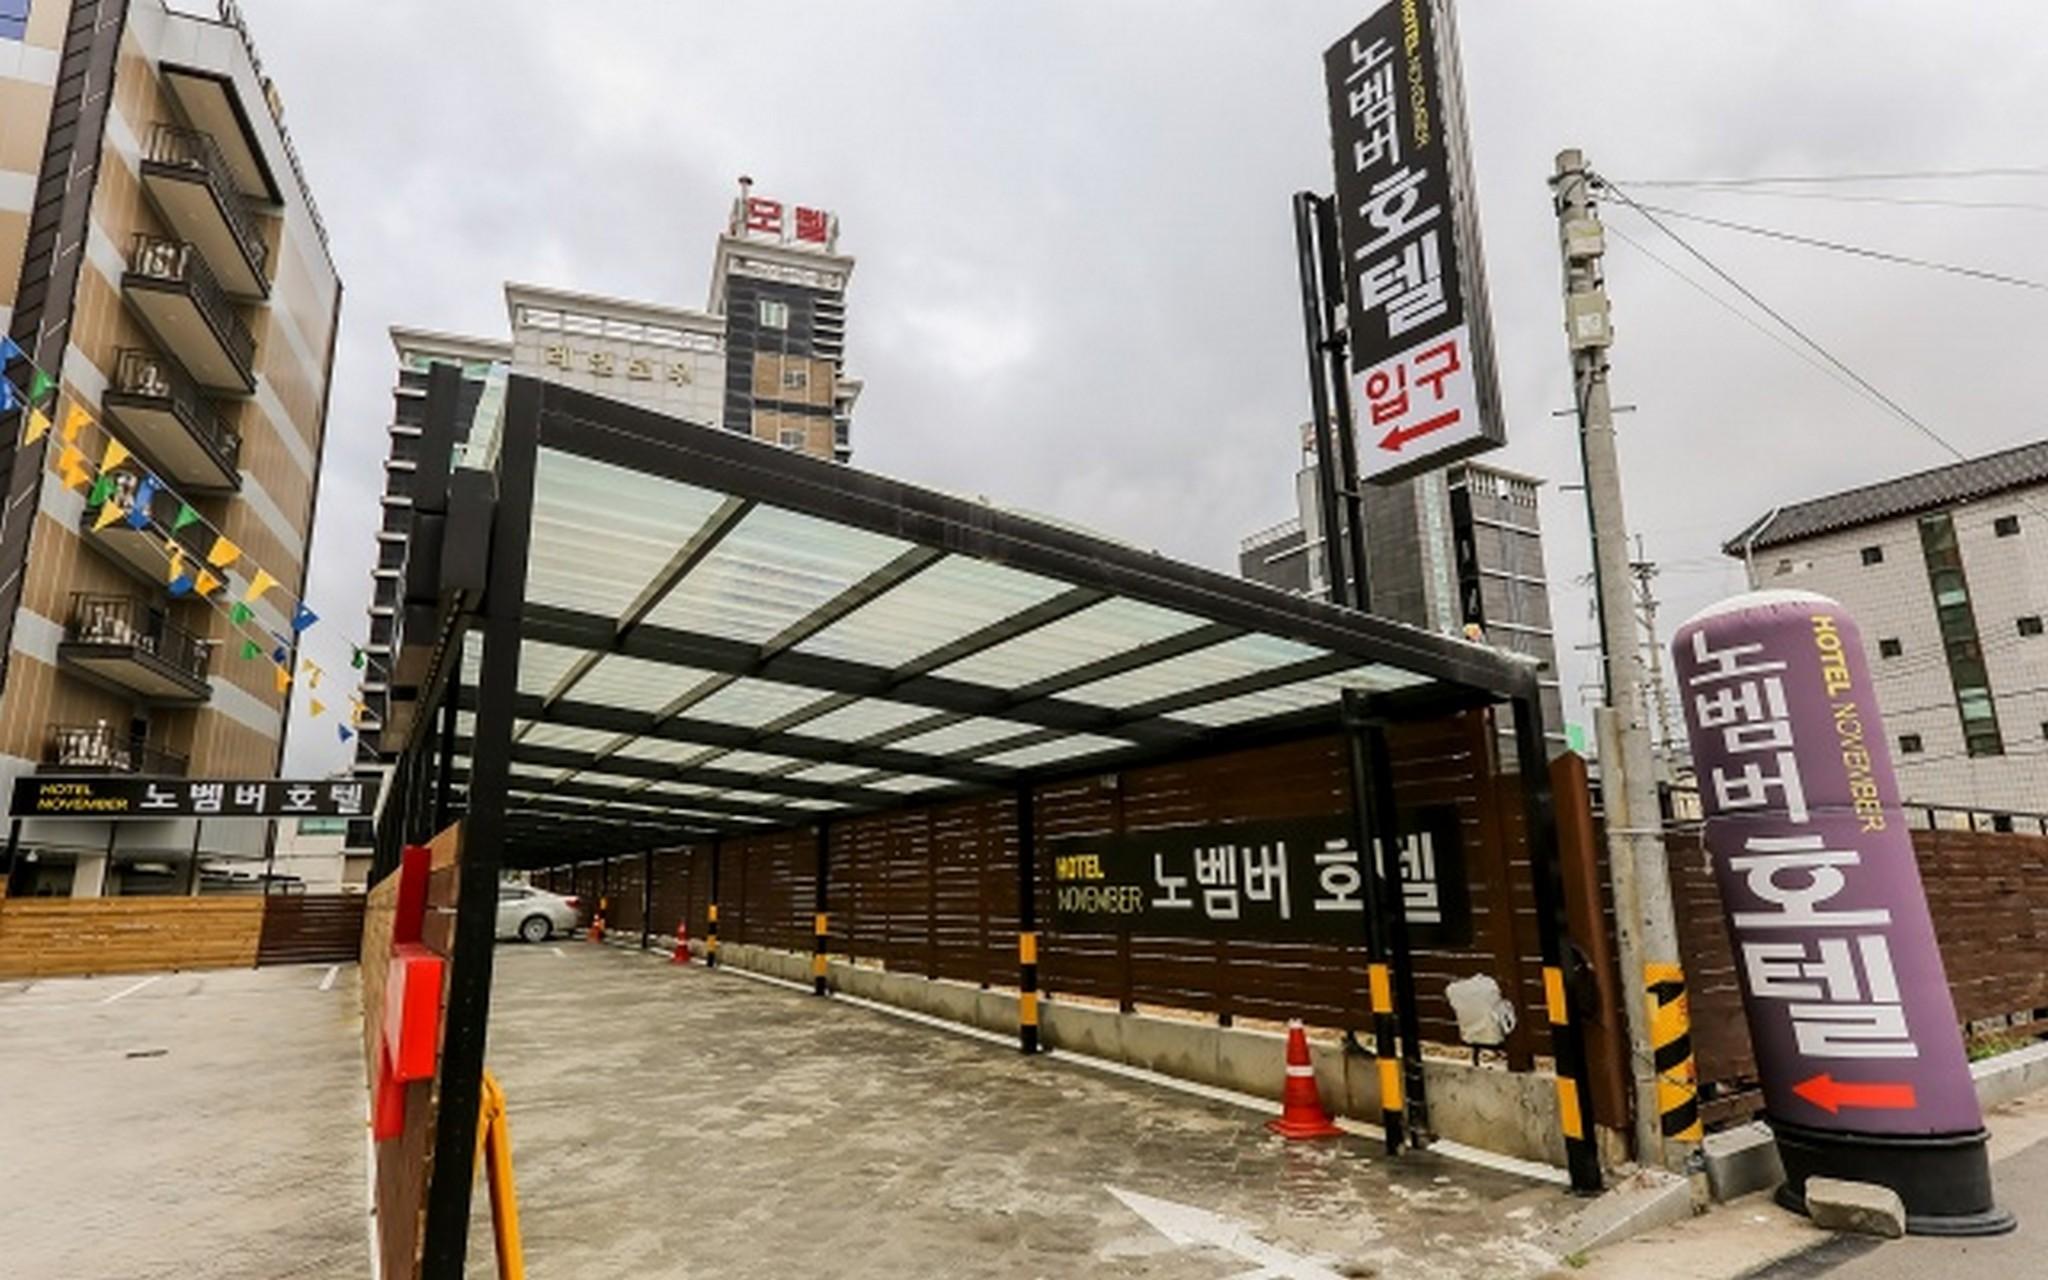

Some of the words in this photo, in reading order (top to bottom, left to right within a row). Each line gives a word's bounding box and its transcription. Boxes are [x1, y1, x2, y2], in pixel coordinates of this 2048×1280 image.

[1365, 339, 1461, 426] 입구
[1809, 614, 1852, 698] HOTEL
[39, 783, 94, 796] HOTEL
[1830, 702, 1887, 834] NOVEMBER
[36, 797, 129, 812] NOVEMBER
[1056, 854, 1105, 879] HOTEL
[1151, 841, 1291, 920] 노벰버
[1057, 885, 1144, 914] NOVEMBER
